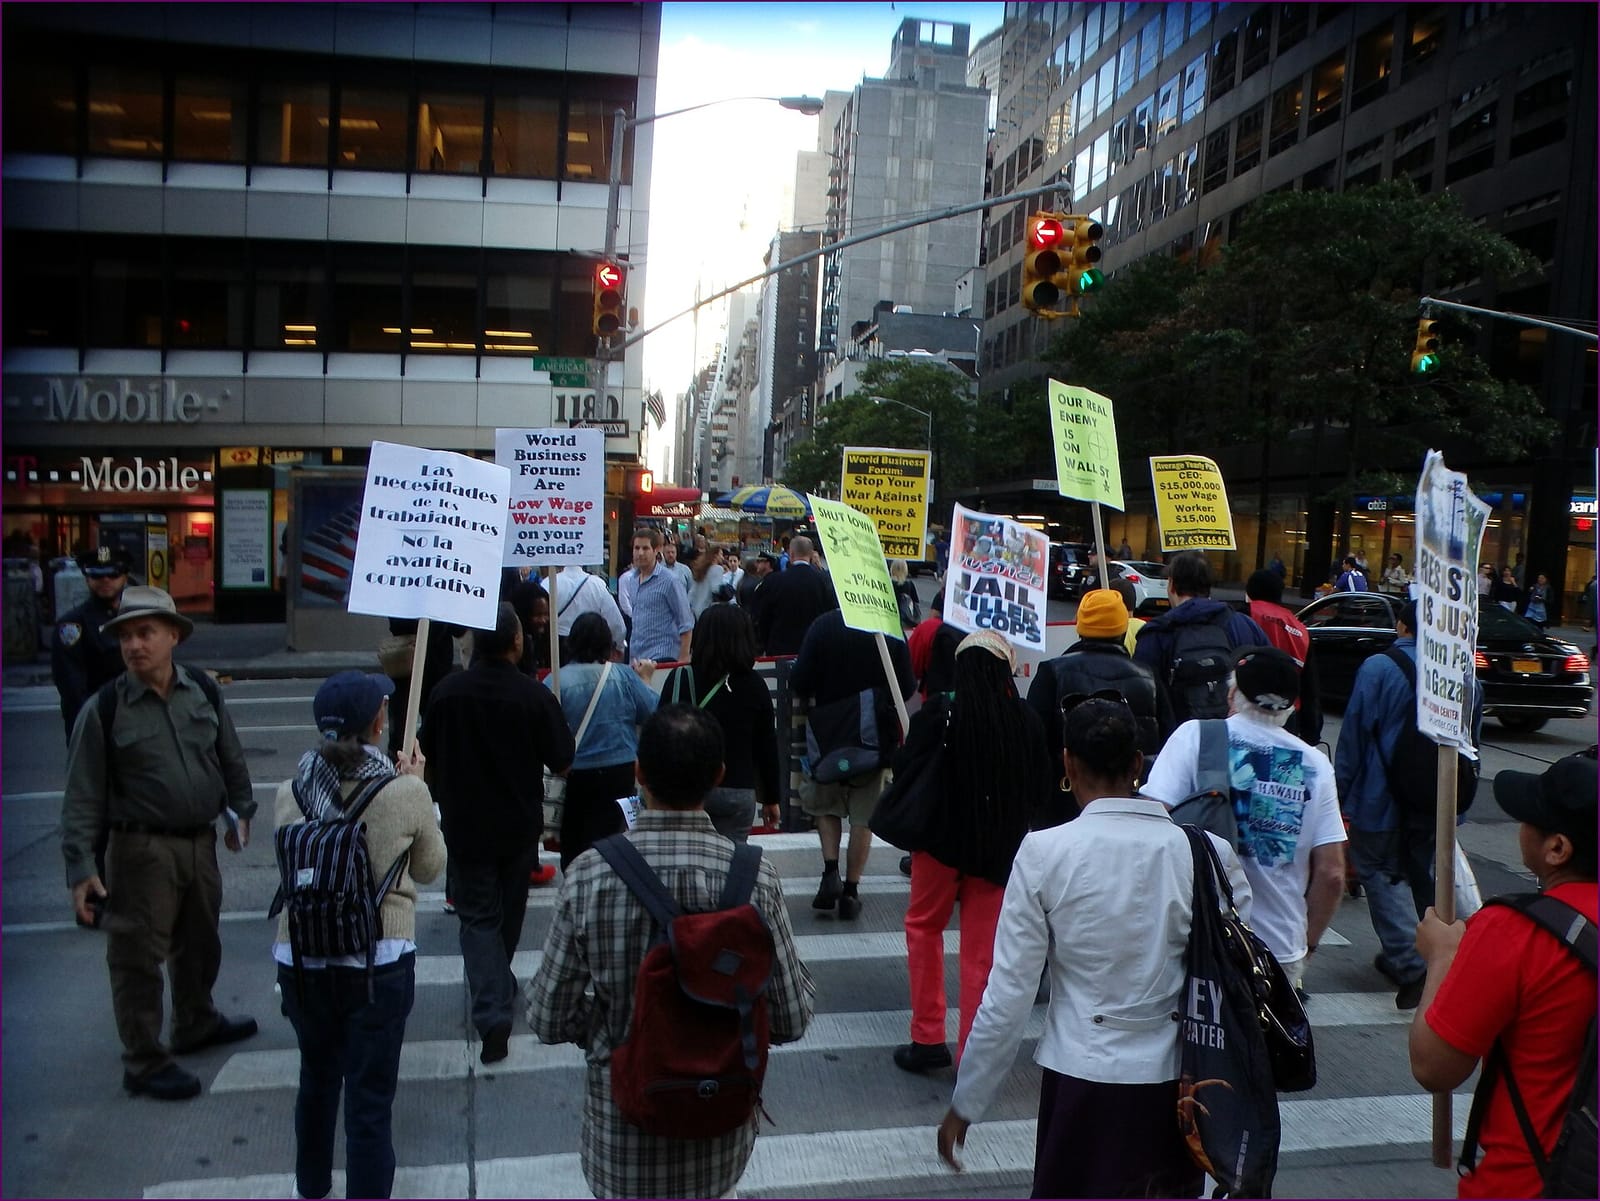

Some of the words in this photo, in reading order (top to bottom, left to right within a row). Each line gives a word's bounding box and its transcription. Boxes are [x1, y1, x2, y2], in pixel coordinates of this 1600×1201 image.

[541, 362, 584, 372] AMERICAS
[559, 375, 567, 385] 6
[43, 378, 201, 423] Mobile
[1058, 393, 1084, 408] OUR
[1086, 399, 1107, 417] REAL
[555, 394, 619, 423] 1180
[1060, 410, 1097, 428] ENEMY
[602, 423, 621, 433] WAY
[1064, 428, 1075, 440] IS
[525, 434, 577, 447] World
[1063, 441, 1081, 454] ON
[514, 449, 587, 462] Business
[849, 455, 879, 464] World
[881, 456, 924, 468] Business
[80, 456, 200, 492] Mobile
[420, 465, 454, 478] Las
[519, 464, 581, 477] Forum:
[867, 465, 904, 476] Forum:
[1065, 456, 1098, 474] WALL
[1100, 465, 1110, 479] ST
[854, 475, 884, 488] Stop
[887, 476, 917, 488] Your
[1178, 471, 1202, 480] CEO:
[373, 474, 499, 504] necesidades
[533, 478, 566, 491] Are
[1160, 481, 1221, 491] $15,000,000
[846, 489, 871, 500] War
[874, 490, 923, 503] Against
[1167, 492, 1188, 500] Low
[1190, 490, 1218, 502] Wage
[412, 497, 432, 507] de
[438, 498, 459, 511] los
[508, 498, 544, 511] Low
[548, 497, 594, 514] Wage
[849, 503, 903, 517] Workers
[906, 507, 917, 518] &
[1174, 504, 1214, 513] Worker:
[370, 506, 499, 536] trabajadores
[512, 513, 587, 526] Workers
[818, 507, 845, 523] SHUT
[1175, 514, 1217, 523] $15,000
[878, 519, 912, 532] Poor!
[432, 535, 453, 550] la
[518, 530, 539, 540] on
[543, 530, 584, 542] your
[1168, 536, 1229, 546] 212.633.6646
[512, 543, 585, 558] Agenda?
[385, 555, 472, 575] avaricia
[956, 572, 1036, 610] JAIL
[952, 588, 1040, 630] KILLER
[1422, 592, 1434, 626] IS
[975, 611, 1042, 643] COPS
[1432, 668, 1463, 704] Gaza
[1259, 783, 1303, 800] HAWAII
[1186, 976, 1224, 1024] EY
